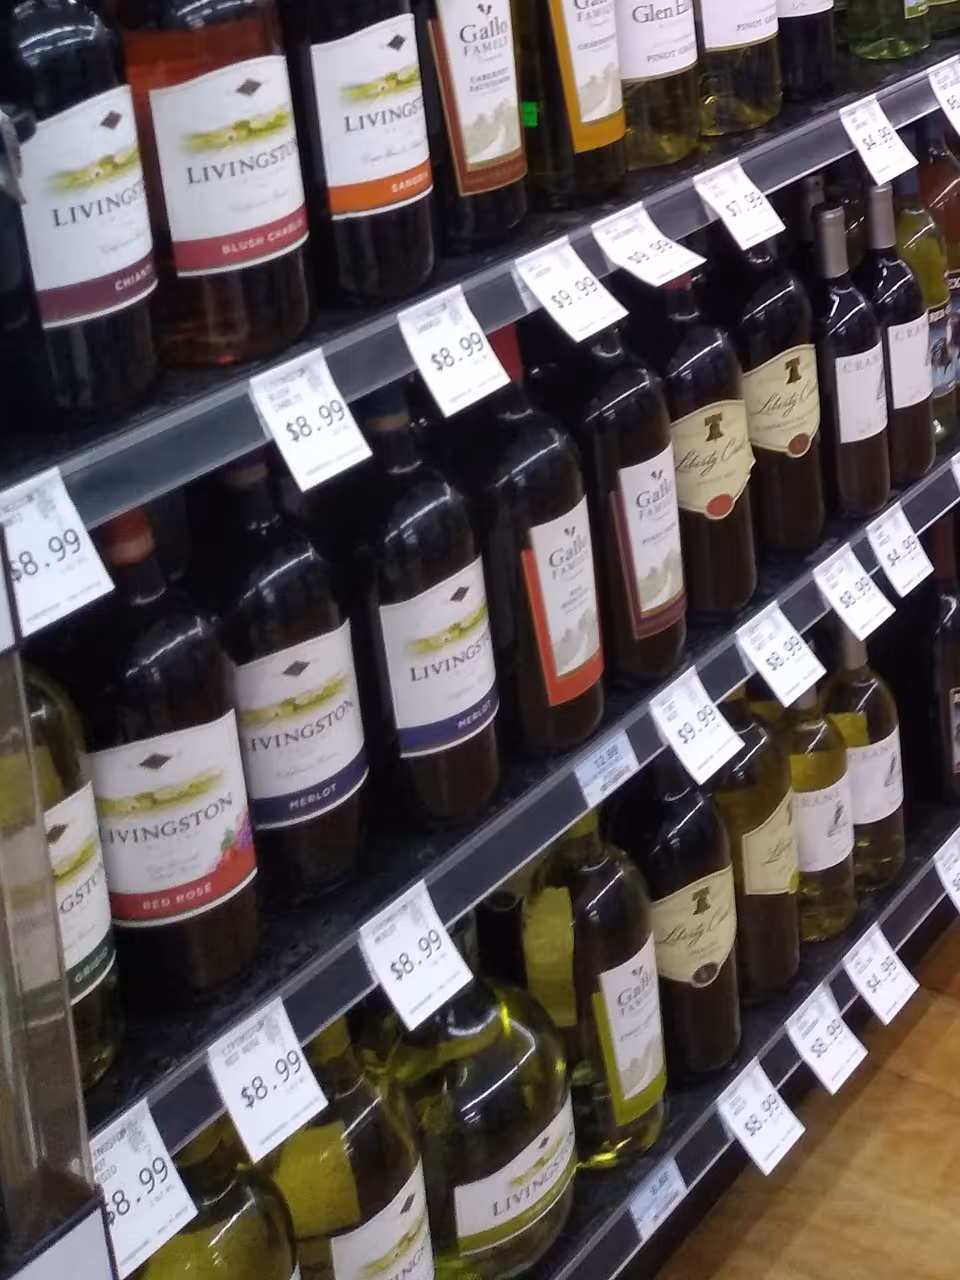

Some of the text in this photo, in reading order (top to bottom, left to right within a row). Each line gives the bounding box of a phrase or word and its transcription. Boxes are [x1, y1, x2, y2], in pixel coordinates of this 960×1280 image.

[459, 16, 509, 44] Gallo
[632, 3, 673, 24] Glen
[724, 190, 765, 217] $7.99
[550, 276, 598, 309] $9.99
[429, 331, 485, 372] $8.99
[285, 399, 345, 442] $8.99
[10, 528, 82, 582] $8.99
[677, 704, 718, 746] $9.99
[288, 781, 337, 811] MERLOT
[142, 882, 213, 911] RED ROSE
[390, 929, 443, 981] $8.99
[241, 1049, 301, 1109] $8.99
[744, 1093, 780, 1137] $8.99
